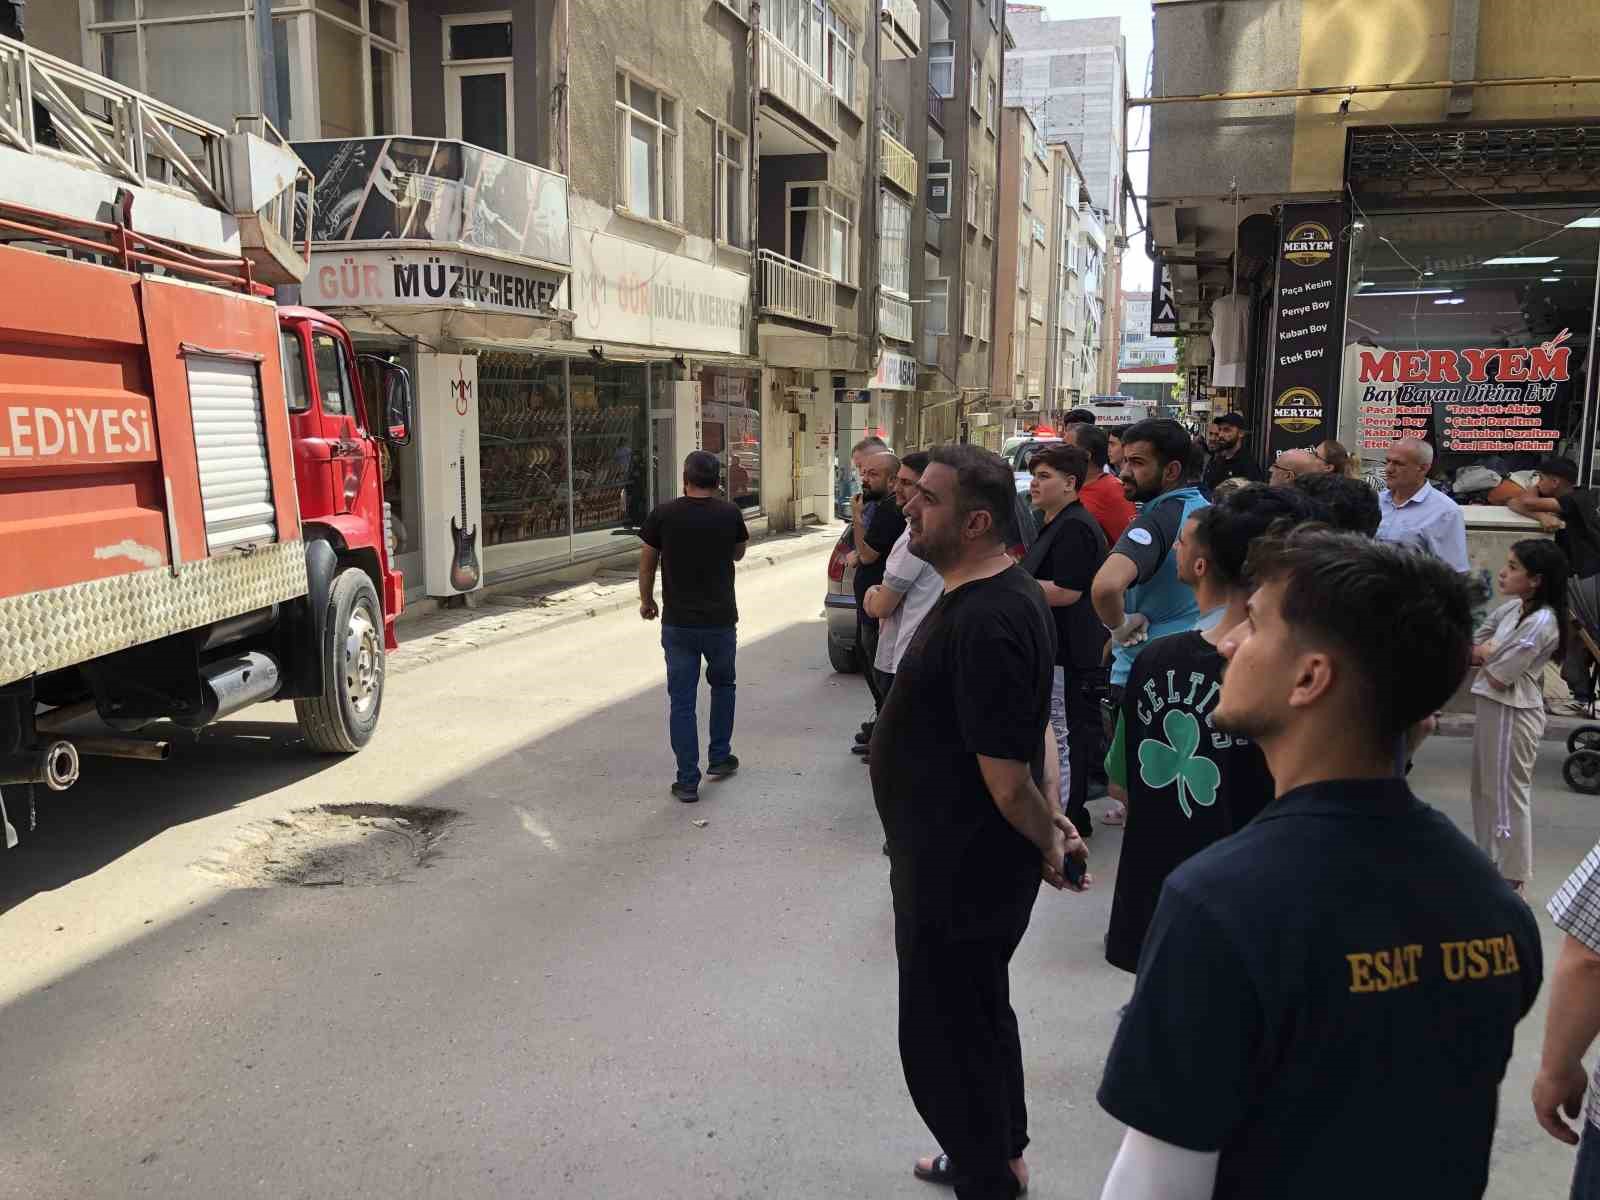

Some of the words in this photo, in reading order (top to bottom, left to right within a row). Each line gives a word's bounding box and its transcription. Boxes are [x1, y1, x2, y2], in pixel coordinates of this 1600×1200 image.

[1283, 241, 1334, 252] MERYEM
[1281, 285, 1303, 298] Paça
[1304, 279, 1333, 292] Kesim
[1281, 303, 1311, 318] Penye
[1311, 300, 1330, 312] Boy
[1279, 326, 1309, 341] Kaban
[1309, 322, 1328, 335] Boy
[1280, 353, 1303, 366] Etek
[1304, 347, 1324, 360] Boy
[1358, 346, 1572, 383] MERYEM
[1363, 386, 1398, 406] Bay
[1399, 384, 1461, 407] Bayan
[1462, 384, 1523, 403] Dikim
[1524, 383, 1558, 403] Evi
[1273, 408, 1323, 417] MERYEM
[1366, 406, 1393, 415] Paça
[1364, 417, 1401, 427] Penye
[1402, 417, 1427, 428] Boy
[1487, 416, 1542, 427] Daraltma
[1363, 430, 1402, 438] Kaban
[1450, 429, 1504, 439] Pantolon
[1504, 428, 1560, 439] Daraltma
[1345, 944, 1423, 993] ESAT
[1439, 933, 1520, 982] USTA
